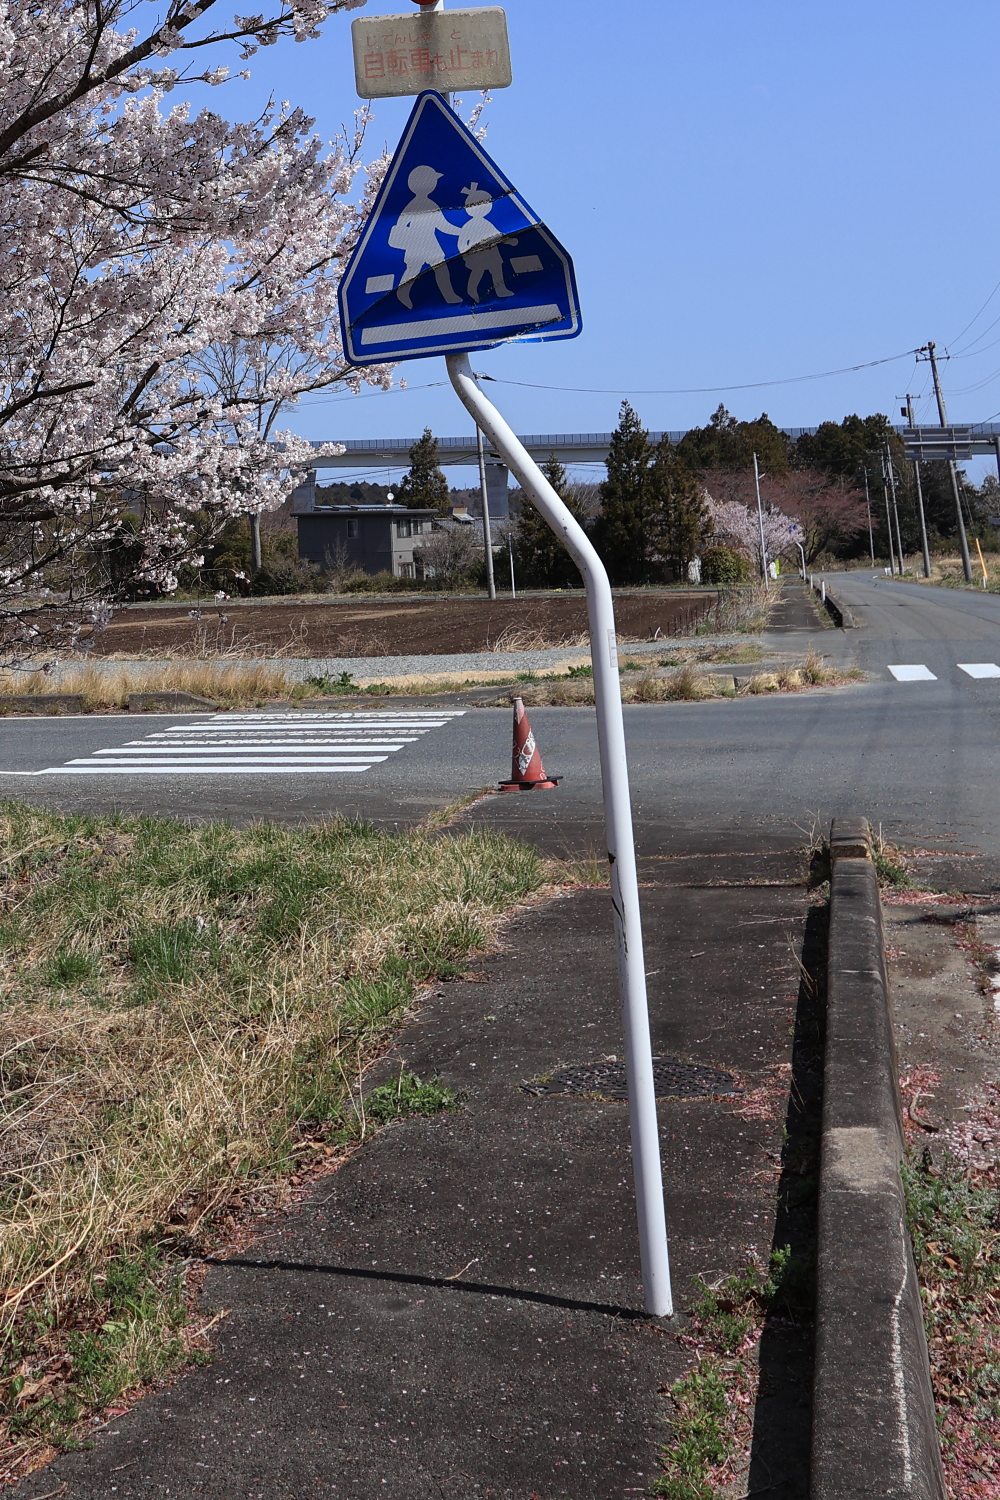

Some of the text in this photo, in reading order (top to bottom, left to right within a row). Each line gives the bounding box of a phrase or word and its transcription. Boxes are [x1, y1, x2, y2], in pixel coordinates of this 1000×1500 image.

[366, 32, 432, 48] じてんしゃ
[363, 44, 500, 79] 自転車も止まれ
